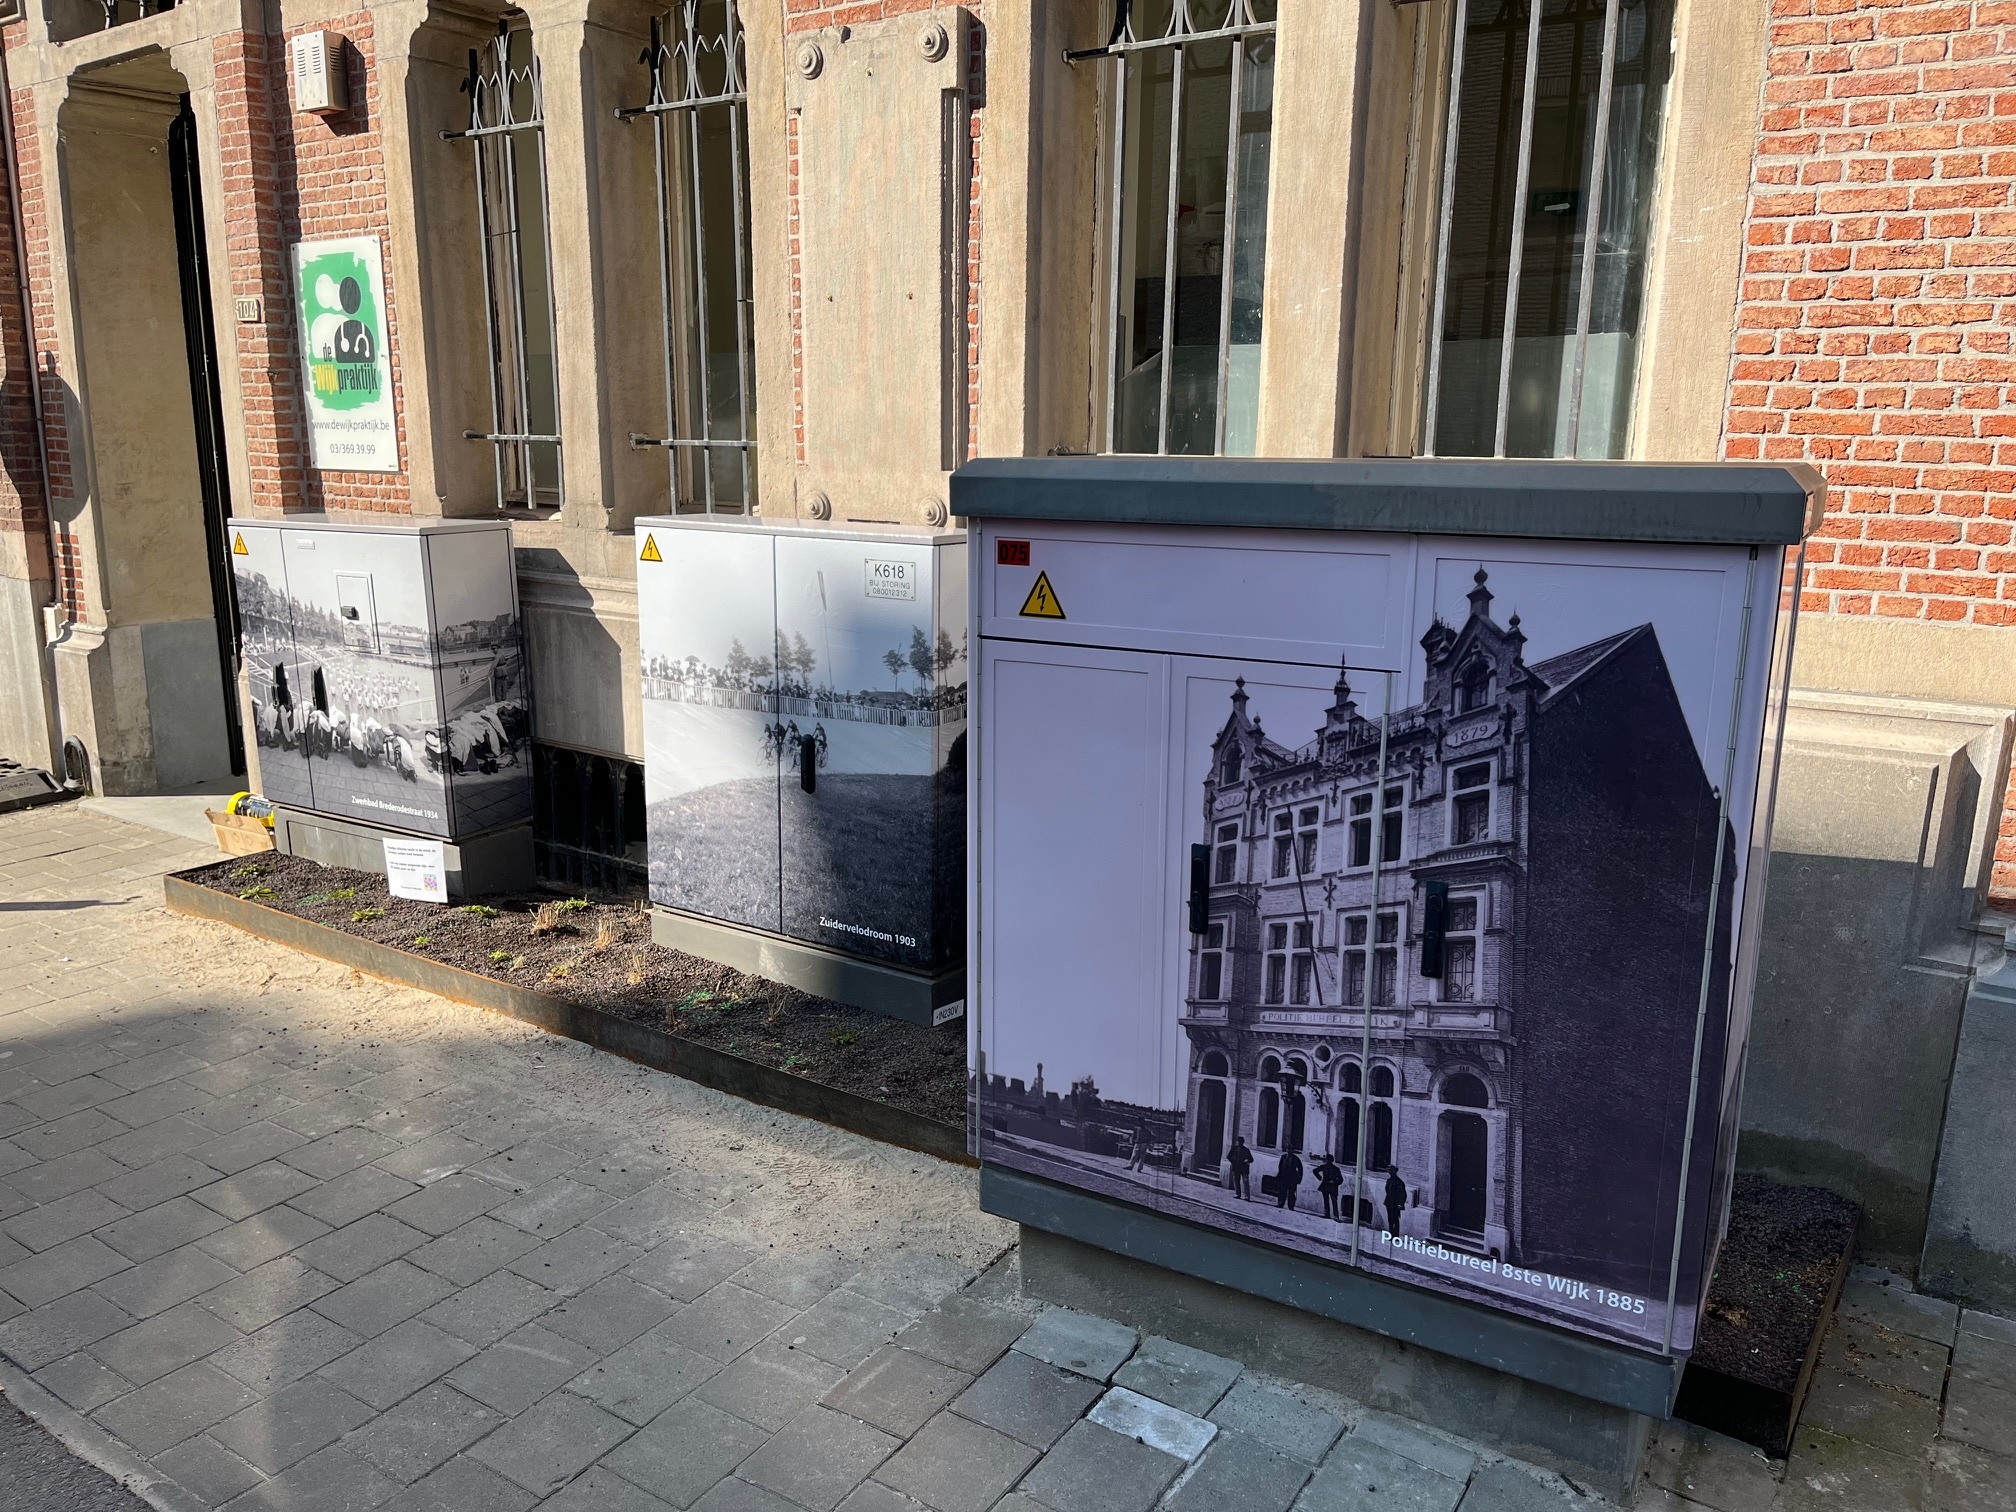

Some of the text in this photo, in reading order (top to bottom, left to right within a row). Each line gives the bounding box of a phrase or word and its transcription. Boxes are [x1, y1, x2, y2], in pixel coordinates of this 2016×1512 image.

[238, 302, 255, 318] 104
[323, 342, 332, 362] de
[312, 419, 390, 433] www.dewijkpraktijk.be
[330, 443, 376, 455] 03/369.39.99
[999, 543, 1028, 563] 075
[874, 564, 905, 579] K618
[869, 579, 911, 590] BIJ STORING
[872, 587, 907, 597] 080012312
[1453, 725, 1488, 744] 1879
[351, 795, 439, 819] Zwembad Brederodestraat 1934
[819, 916, 916, 947] Zuidervelodroom 1903
[1380, 1230, 1646, 1315] Politiebureel 8ste Wijk 1885
